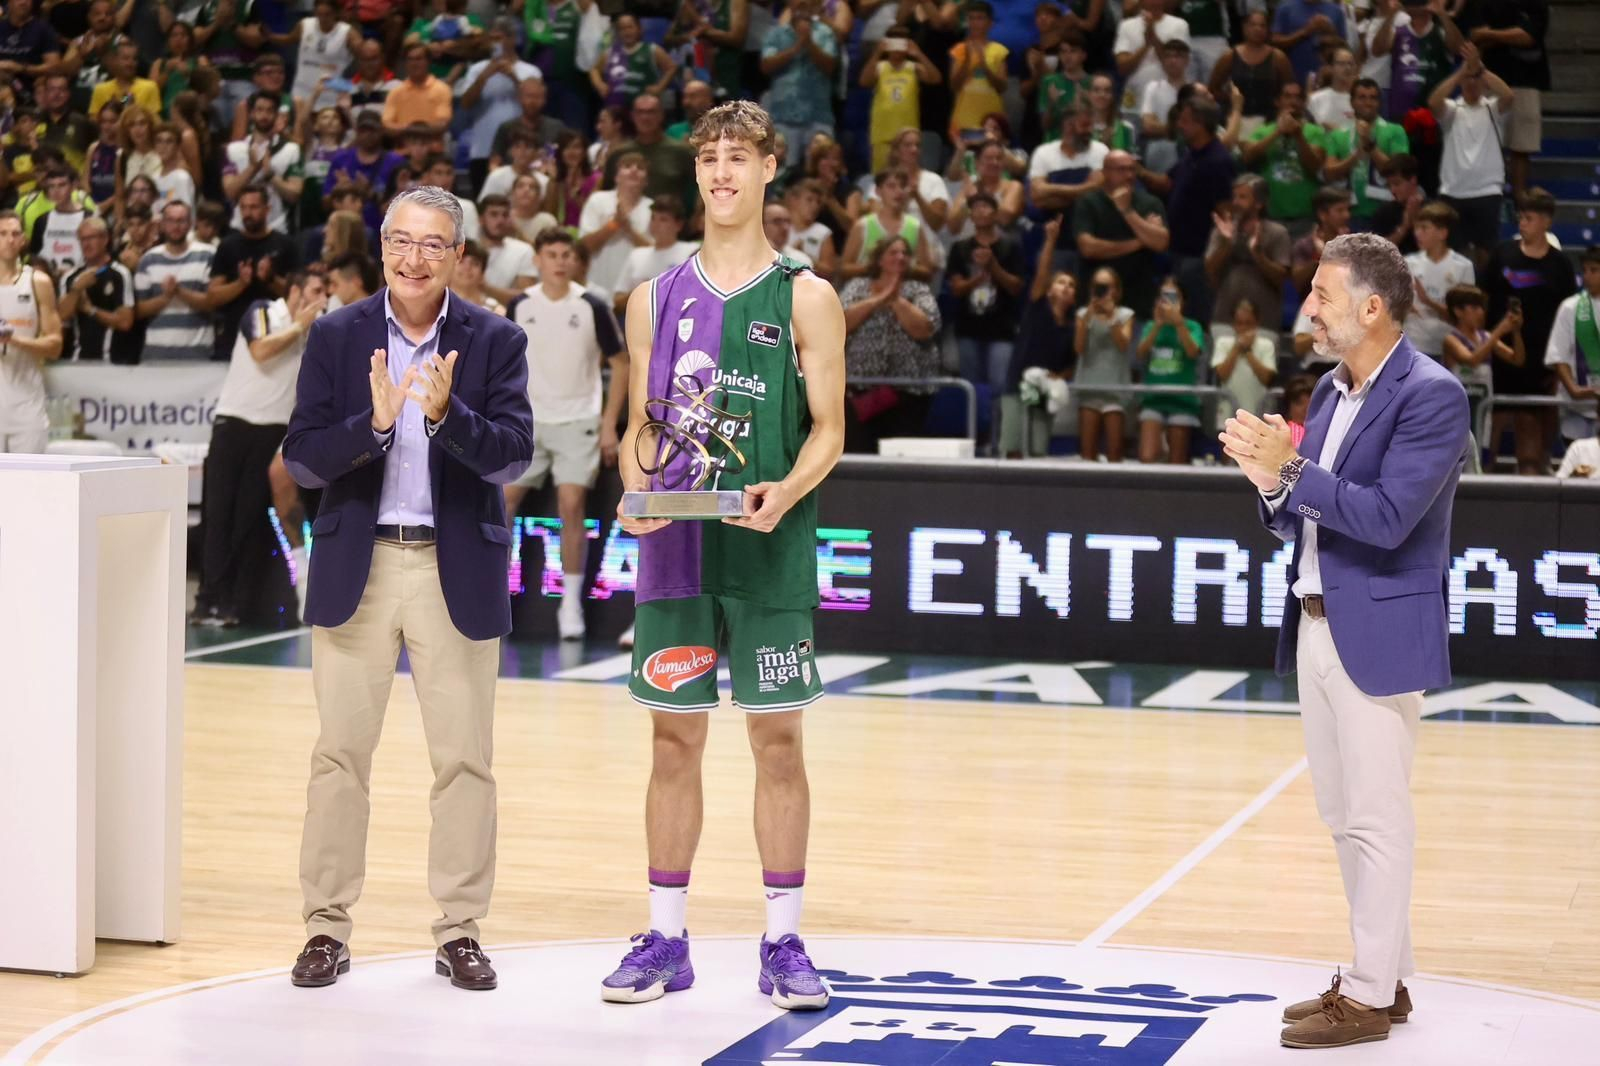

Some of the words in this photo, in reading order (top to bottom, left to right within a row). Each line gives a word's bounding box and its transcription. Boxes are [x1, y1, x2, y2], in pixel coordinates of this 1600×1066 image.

[711, 369, 766, 394] Unicaja
[756, 645, 776, 654] sabor
[650, 649, 714, 680] famadesa
[757, 663, 800, 685] laga
